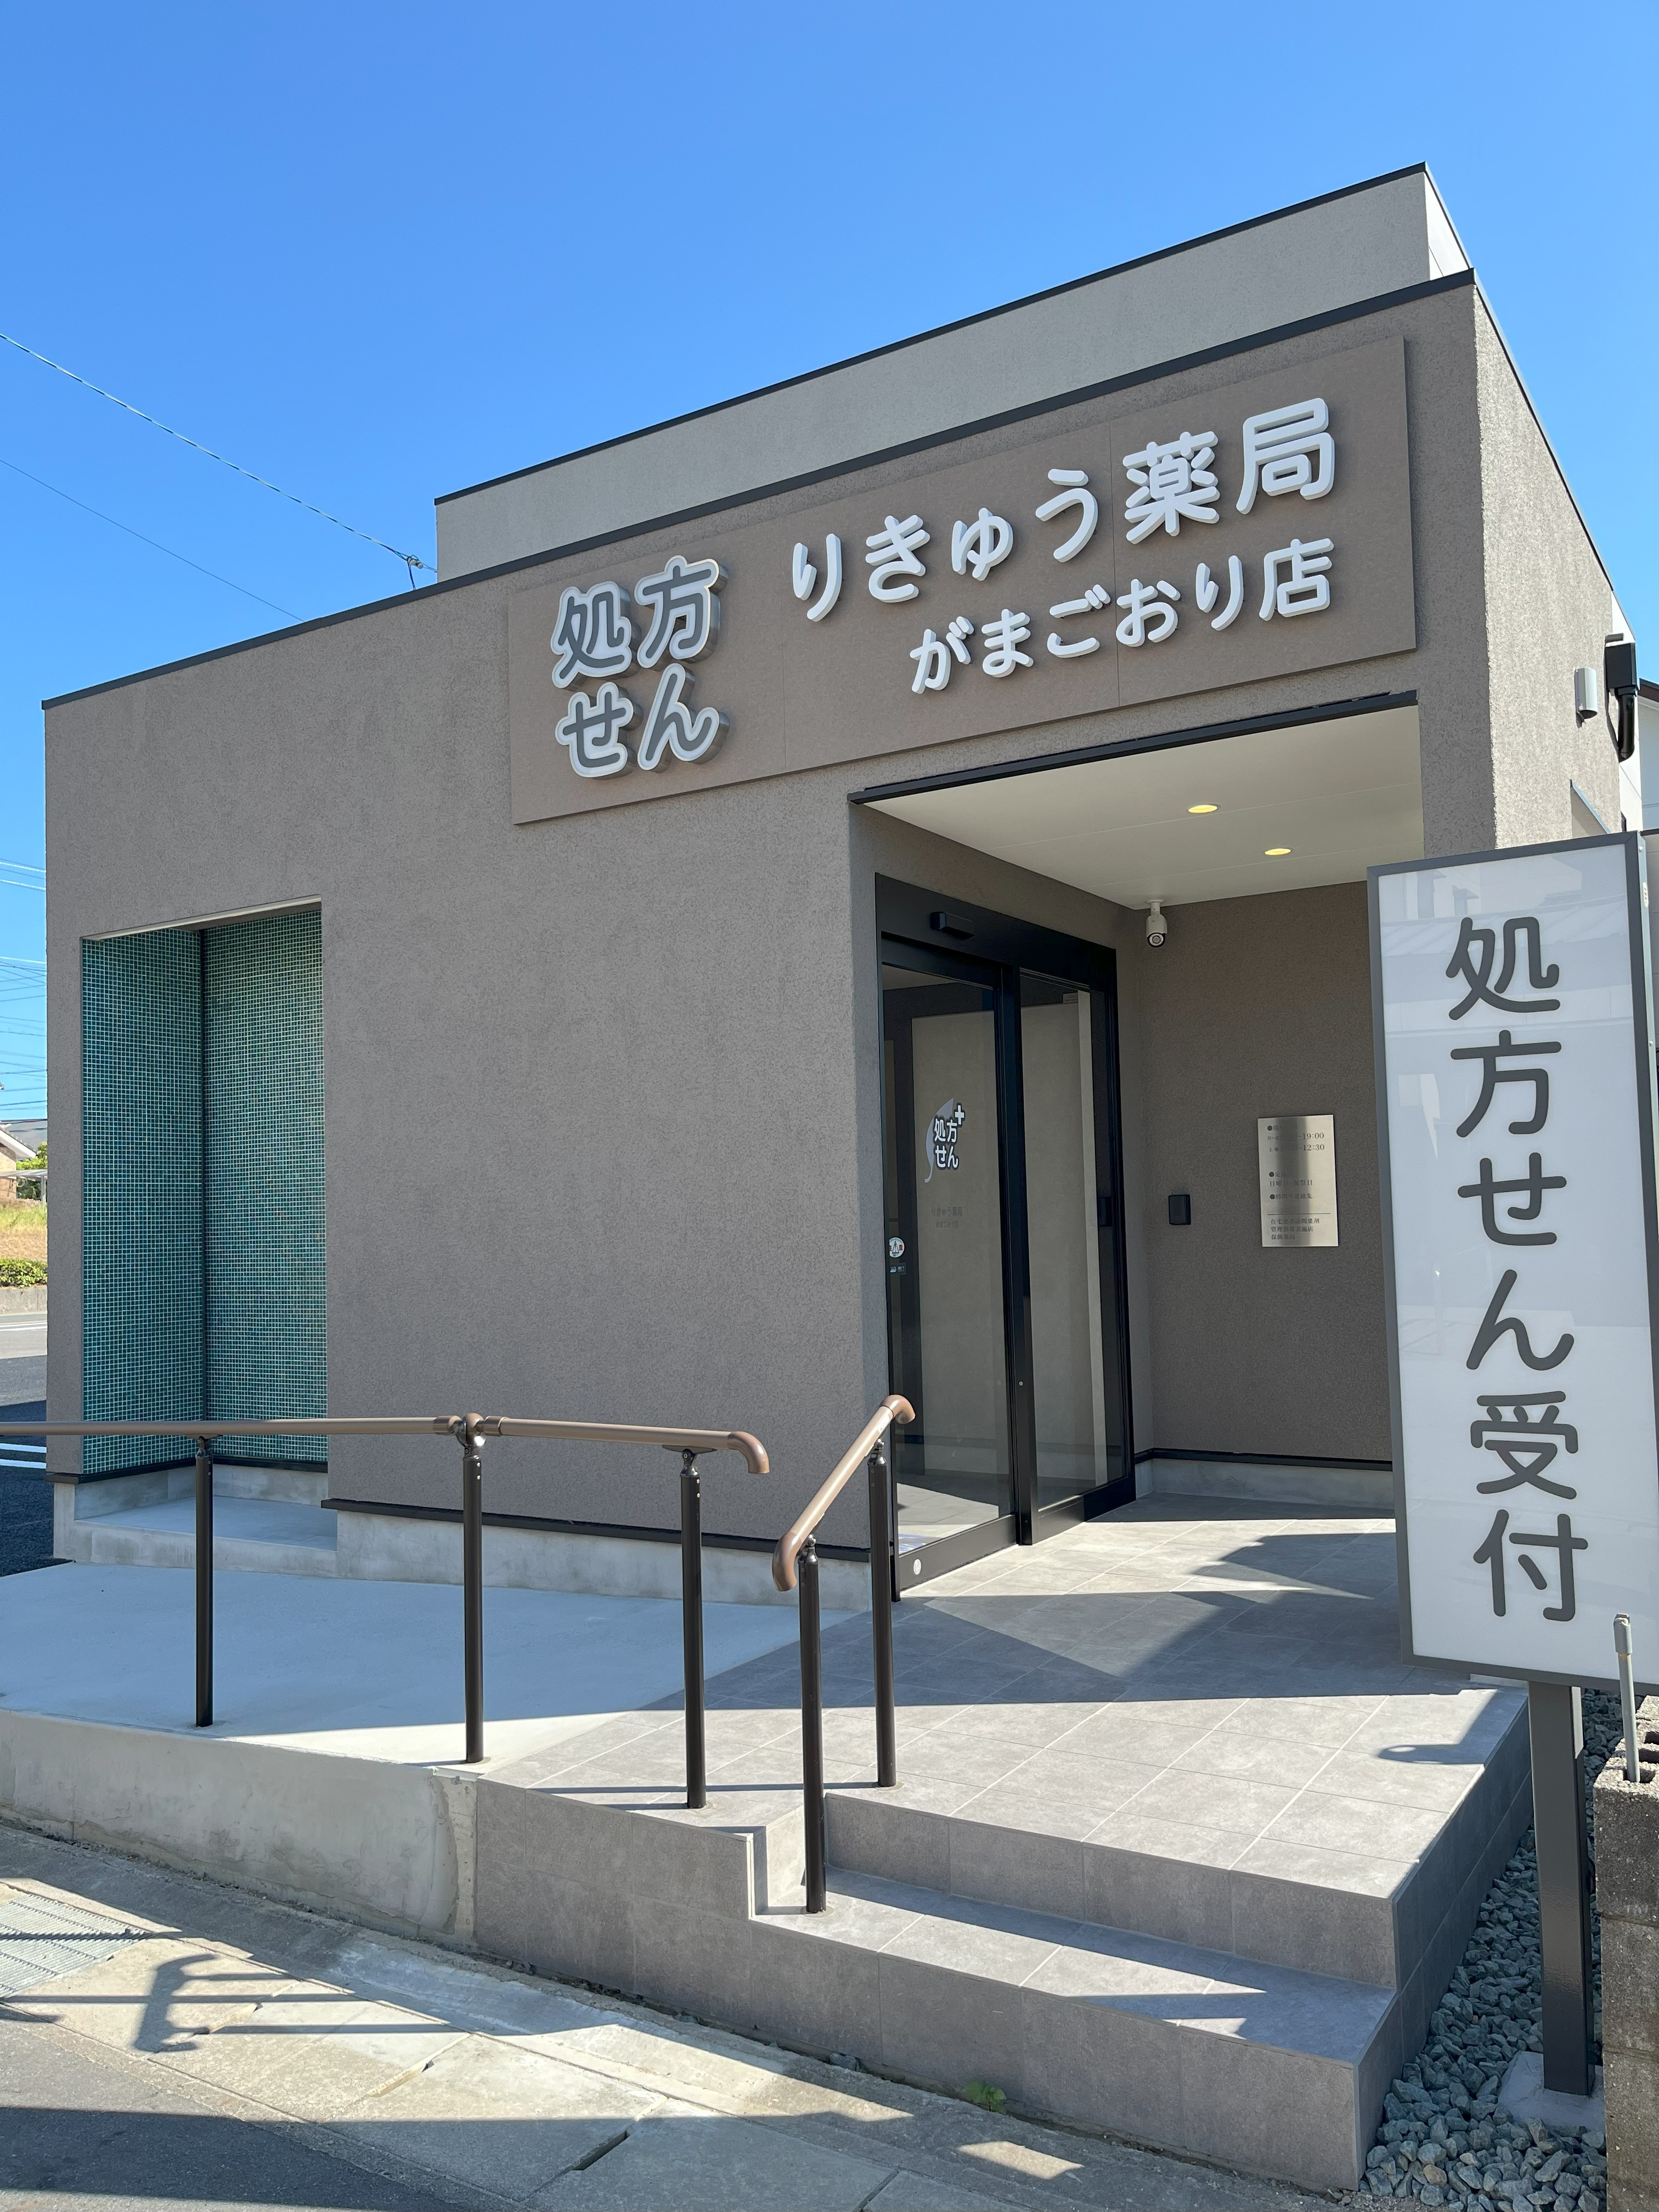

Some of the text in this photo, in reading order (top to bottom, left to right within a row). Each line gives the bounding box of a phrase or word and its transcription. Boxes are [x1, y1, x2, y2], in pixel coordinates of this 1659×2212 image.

[792, 397, 1337, 623] りきゅう薬局
[551, 555, 729, 691] 処方
[909, 538, 1335, 695] がまごおり店
[554, 663, 731, 779] せん
[934, 1117, 958, 1143] 処方
[935, 1144, 958, 1169] せん
[1445, 916, 1589, 1623] 処方せん受付
